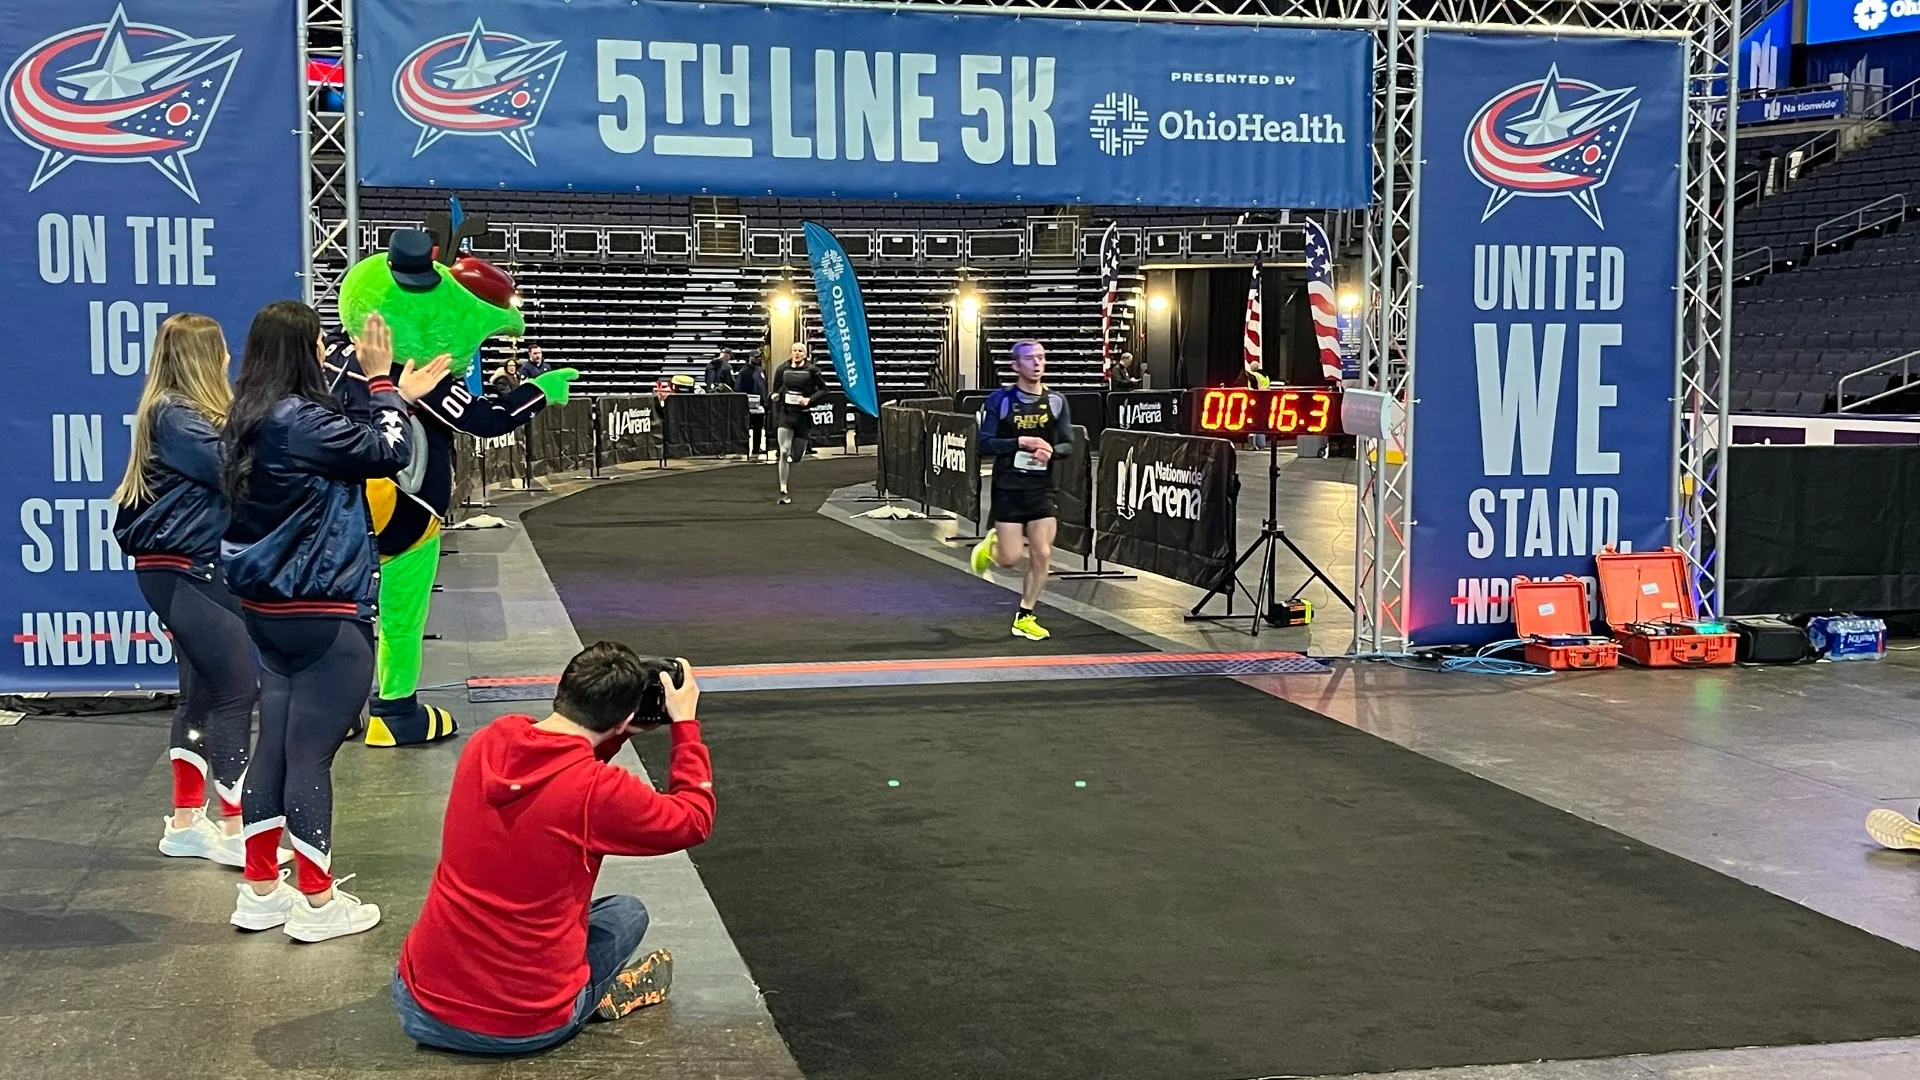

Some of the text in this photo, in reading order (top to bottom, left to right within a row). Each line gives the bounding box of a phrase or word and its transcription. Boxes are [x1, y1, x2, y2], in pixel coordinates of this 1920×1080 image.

[769, 46, 938, 162] LINE
[960, 54, 1058, 166] 5K
[1171, 71, 1296, 87] PRESENTED BY
[1158, 111, 1346, 145] OhioHealth
[38, 213, 216, 286] ON THE
[1473, 245, 1625, 311] UNITED
[832, 285, 858, 388] OhioHealth
[441, 384, 472, 419] 00
[1131, 405, 1162, 425] Arena
[1473, 323, 1623, 476] WE
[52, 414, 104, 481] IN
[1155, 460, 1203, 485] Nationwide
[1138, 465, 1202, 521] Arena
[1467, 487, 1633, 559] STAND.
